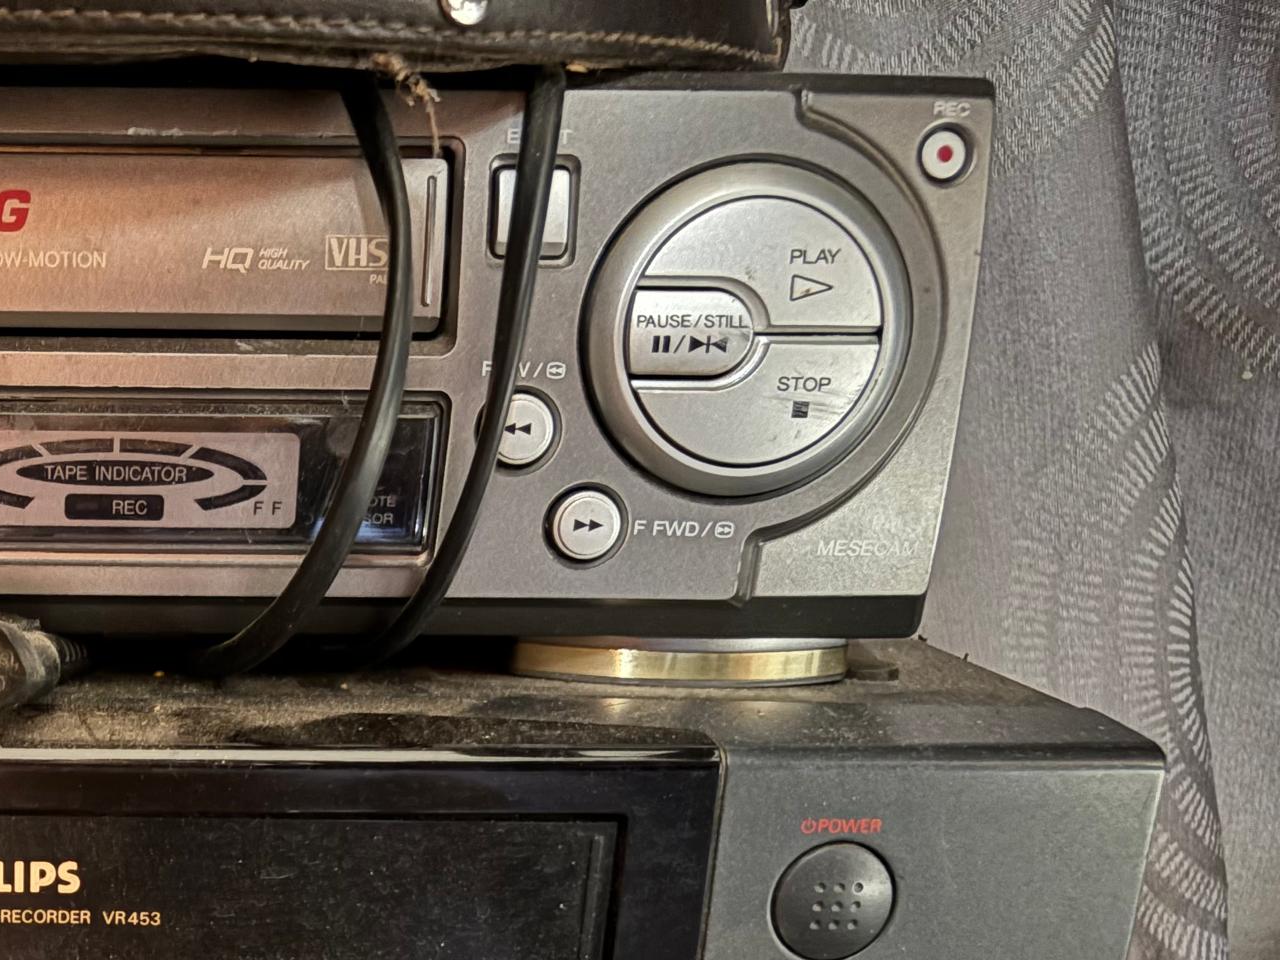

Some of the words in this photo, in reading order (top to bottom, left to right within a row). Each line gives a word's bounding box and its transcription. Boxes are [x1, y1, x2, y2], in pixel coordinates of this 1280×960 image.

[933, 101, 971, 117] REC
[201, 247, 254, 273] HQ
[259, 247, 288, 258] HIGH
[328, 237, 389, 268] VHS
[790, 249, 841, 265] PLAY
[258, 259, 310, 271] QUALITY
[636, 313, 749, 329] PAUSE/STILL
[776, 376, 831, 392] STOP
[44, 465, 87, 481] TAPE
[95, 465, 187, 482] INDICATOR
[112, 500, 147, 516] REC
[816, 539, 919, 557] MESECAM
[817, 818, 883, 834] POWER
[0, 909, 91, 925] RECORDER
[102, 910, 161, 926] VR453
